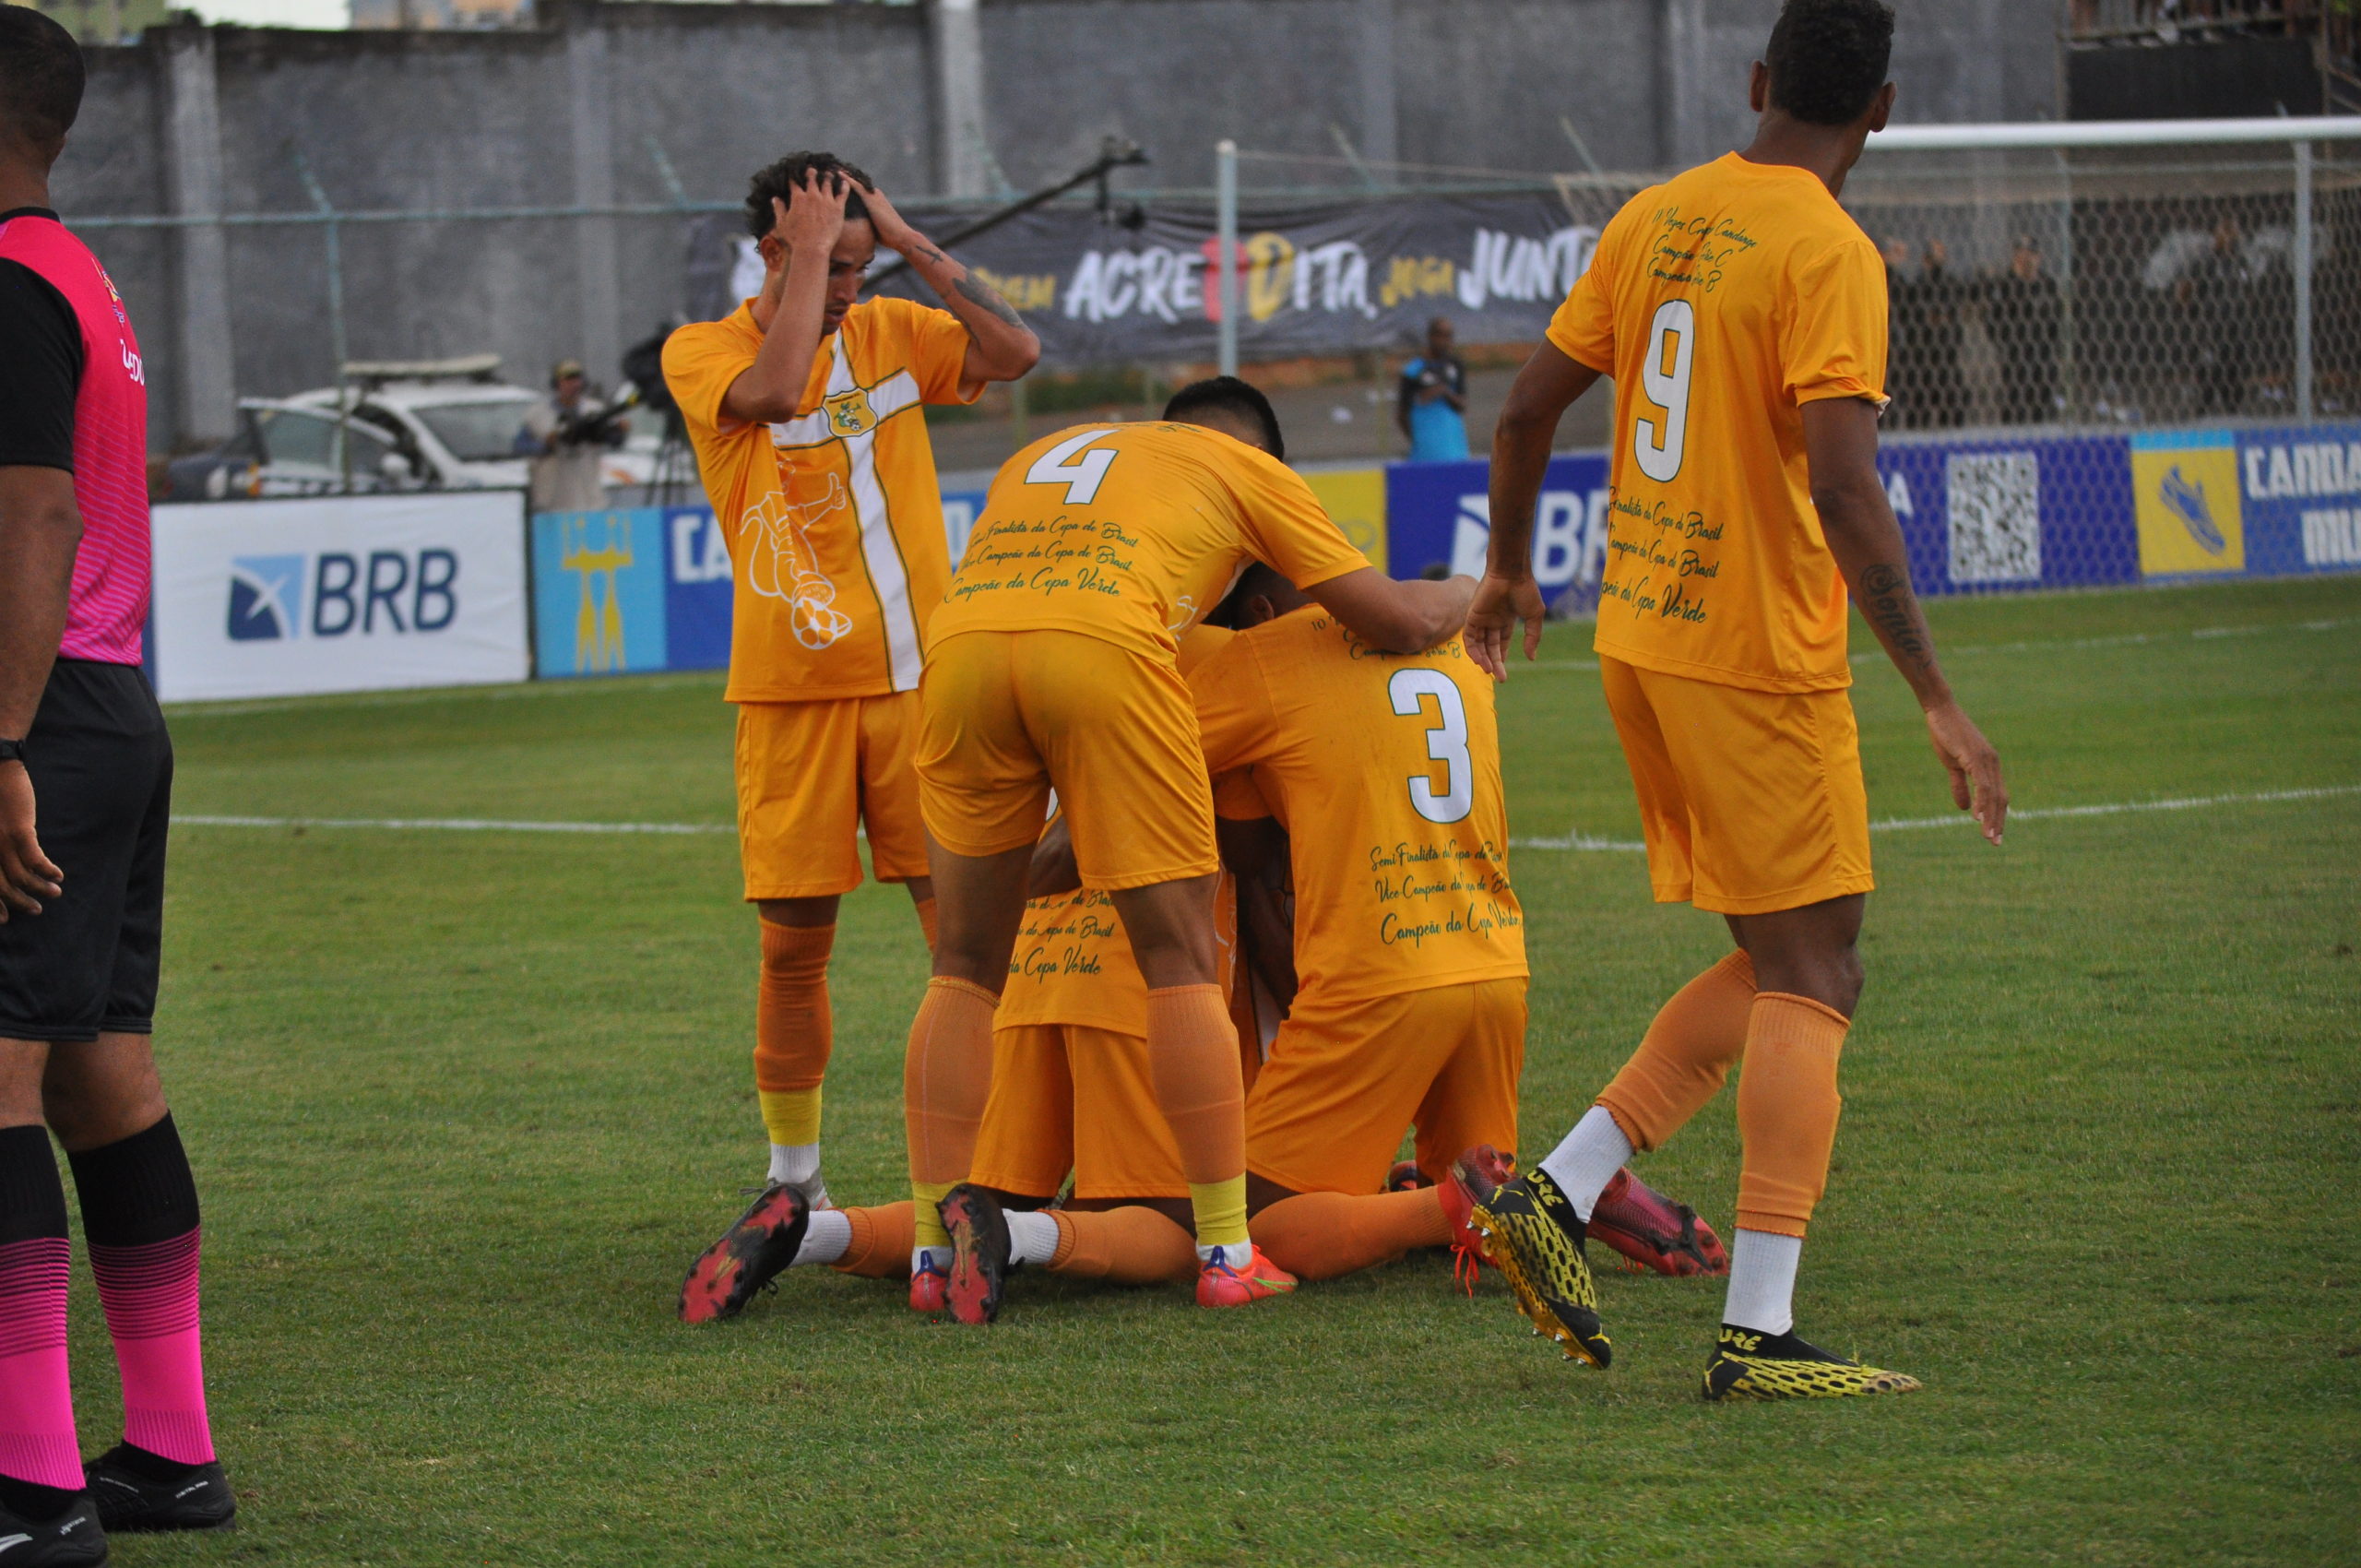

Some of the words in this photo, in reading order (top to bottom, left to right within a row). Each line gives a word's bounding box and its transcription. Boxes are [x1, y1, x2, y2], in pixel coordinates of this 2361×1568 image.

[1714, 248, 1734, 267] C
[1634, 299, 1695, 483] 9
[1024, 429, 1121, 505] 4
[1049, 516, 1079, 537] Copa
[1100, 522, 1139, 548] Brasil
[1685, 511, 1724, 540] Brasil
[977, 544, 1023, 566] Campeão
[1045, 540, 1074, 563] Copa
[1095, 545, 1133, 571] Brasil
[1679, 549, 1720, 578] Brasil
[313, 549, 458, 637] BRB
[944, 577, 1001, 603] Campeão
[1005, 572, 1026, 588] da
[1030, 566, 1071, 596] Copa
[1077, 567, 1121, 596] Verde
[1661, 582, 1707, 624] Verde
[1388, 668, 1474, 824] 3
[1370, 846, 1396, 873] Semi
[1395, 841, 1440, 867] Finalista
[1375, 877, 1400, 903] Vice
[1402, 874, 1447, 903] Campeão
[1079, 915, 1116, 939] Brasil
[1381, 912, 1441, 949] Campeão
[1445, 910, 1464, 933] da
[1024, 946, 1059, 985] Copa
[1062, 944, 1103, 976] Verde
